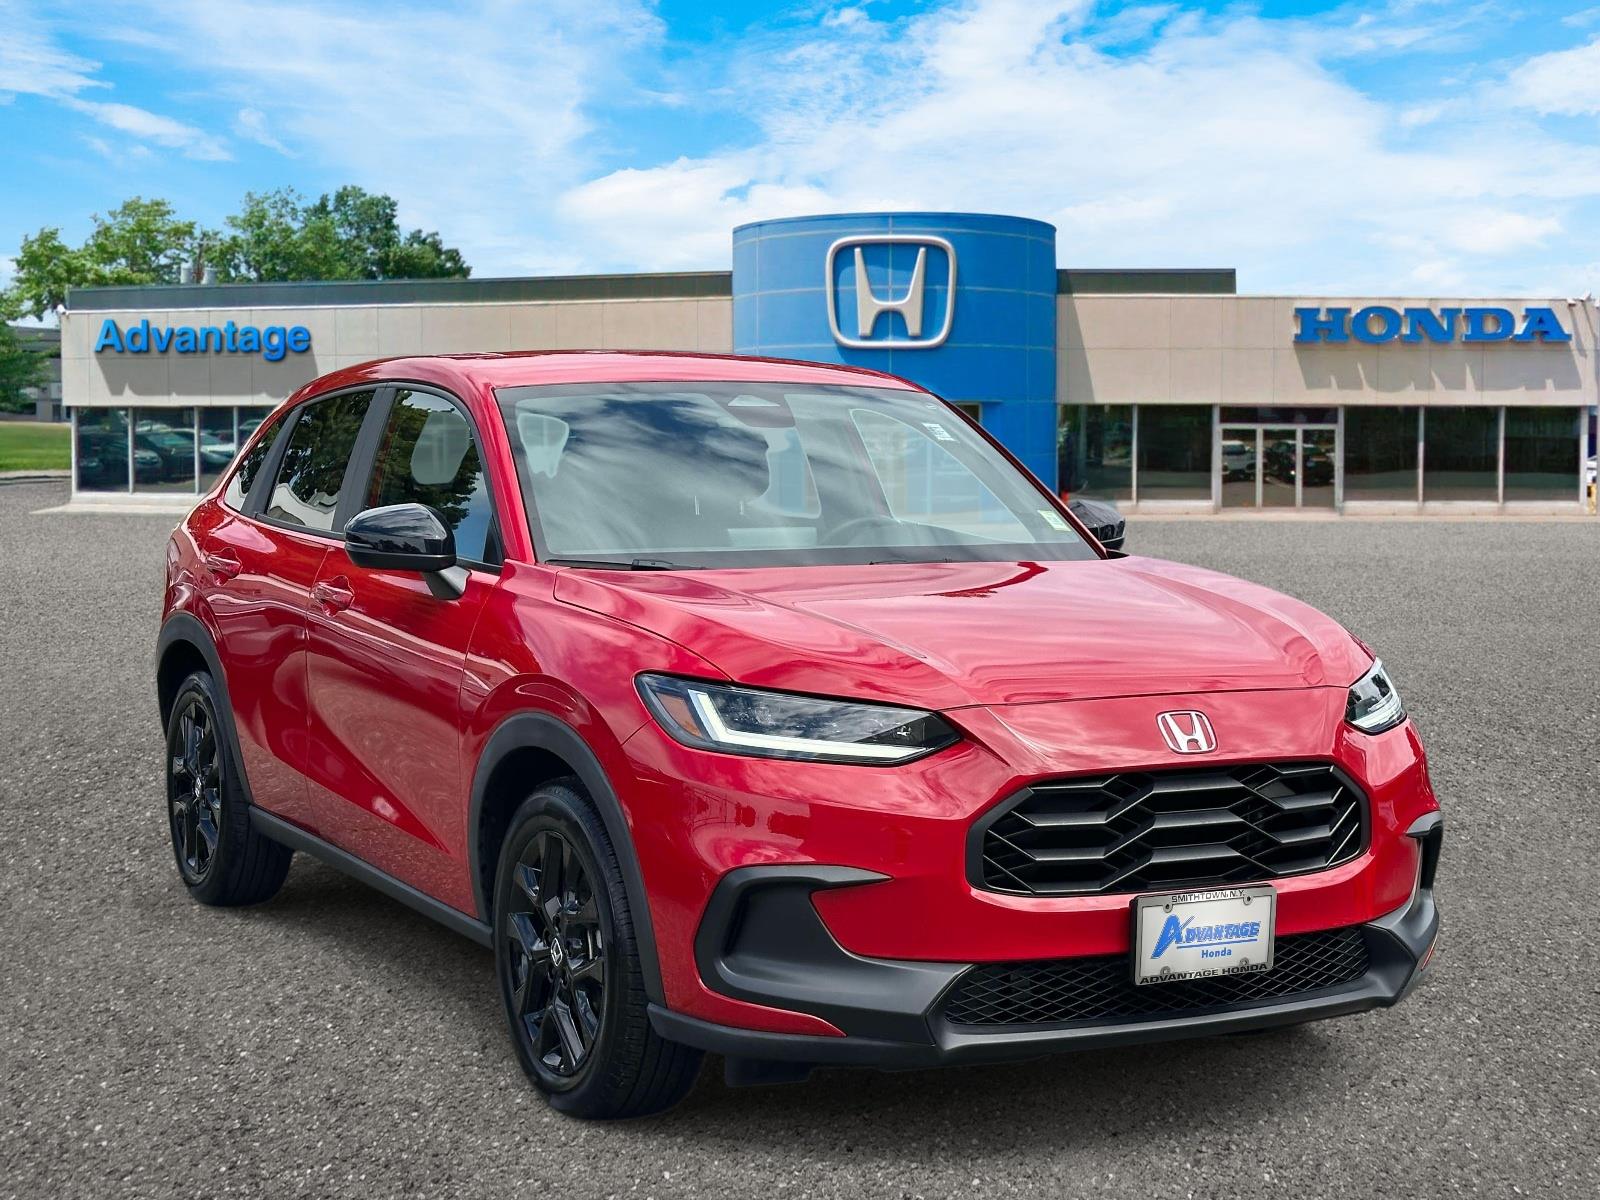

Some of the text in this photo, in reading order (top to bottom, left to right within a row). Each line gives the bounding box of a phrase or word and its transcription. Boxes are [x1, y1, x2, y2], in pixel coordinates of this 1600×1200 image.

[95, 318, 311, 362] Advantage
[1294, 306, 1573, 343] HONDA
[1150, 914, 1261, 960] ADVANTAGE
[1201, 947, 1232, 958] Honda
[1139, 963, 1268, 984] ADVANTAGE HONDA
